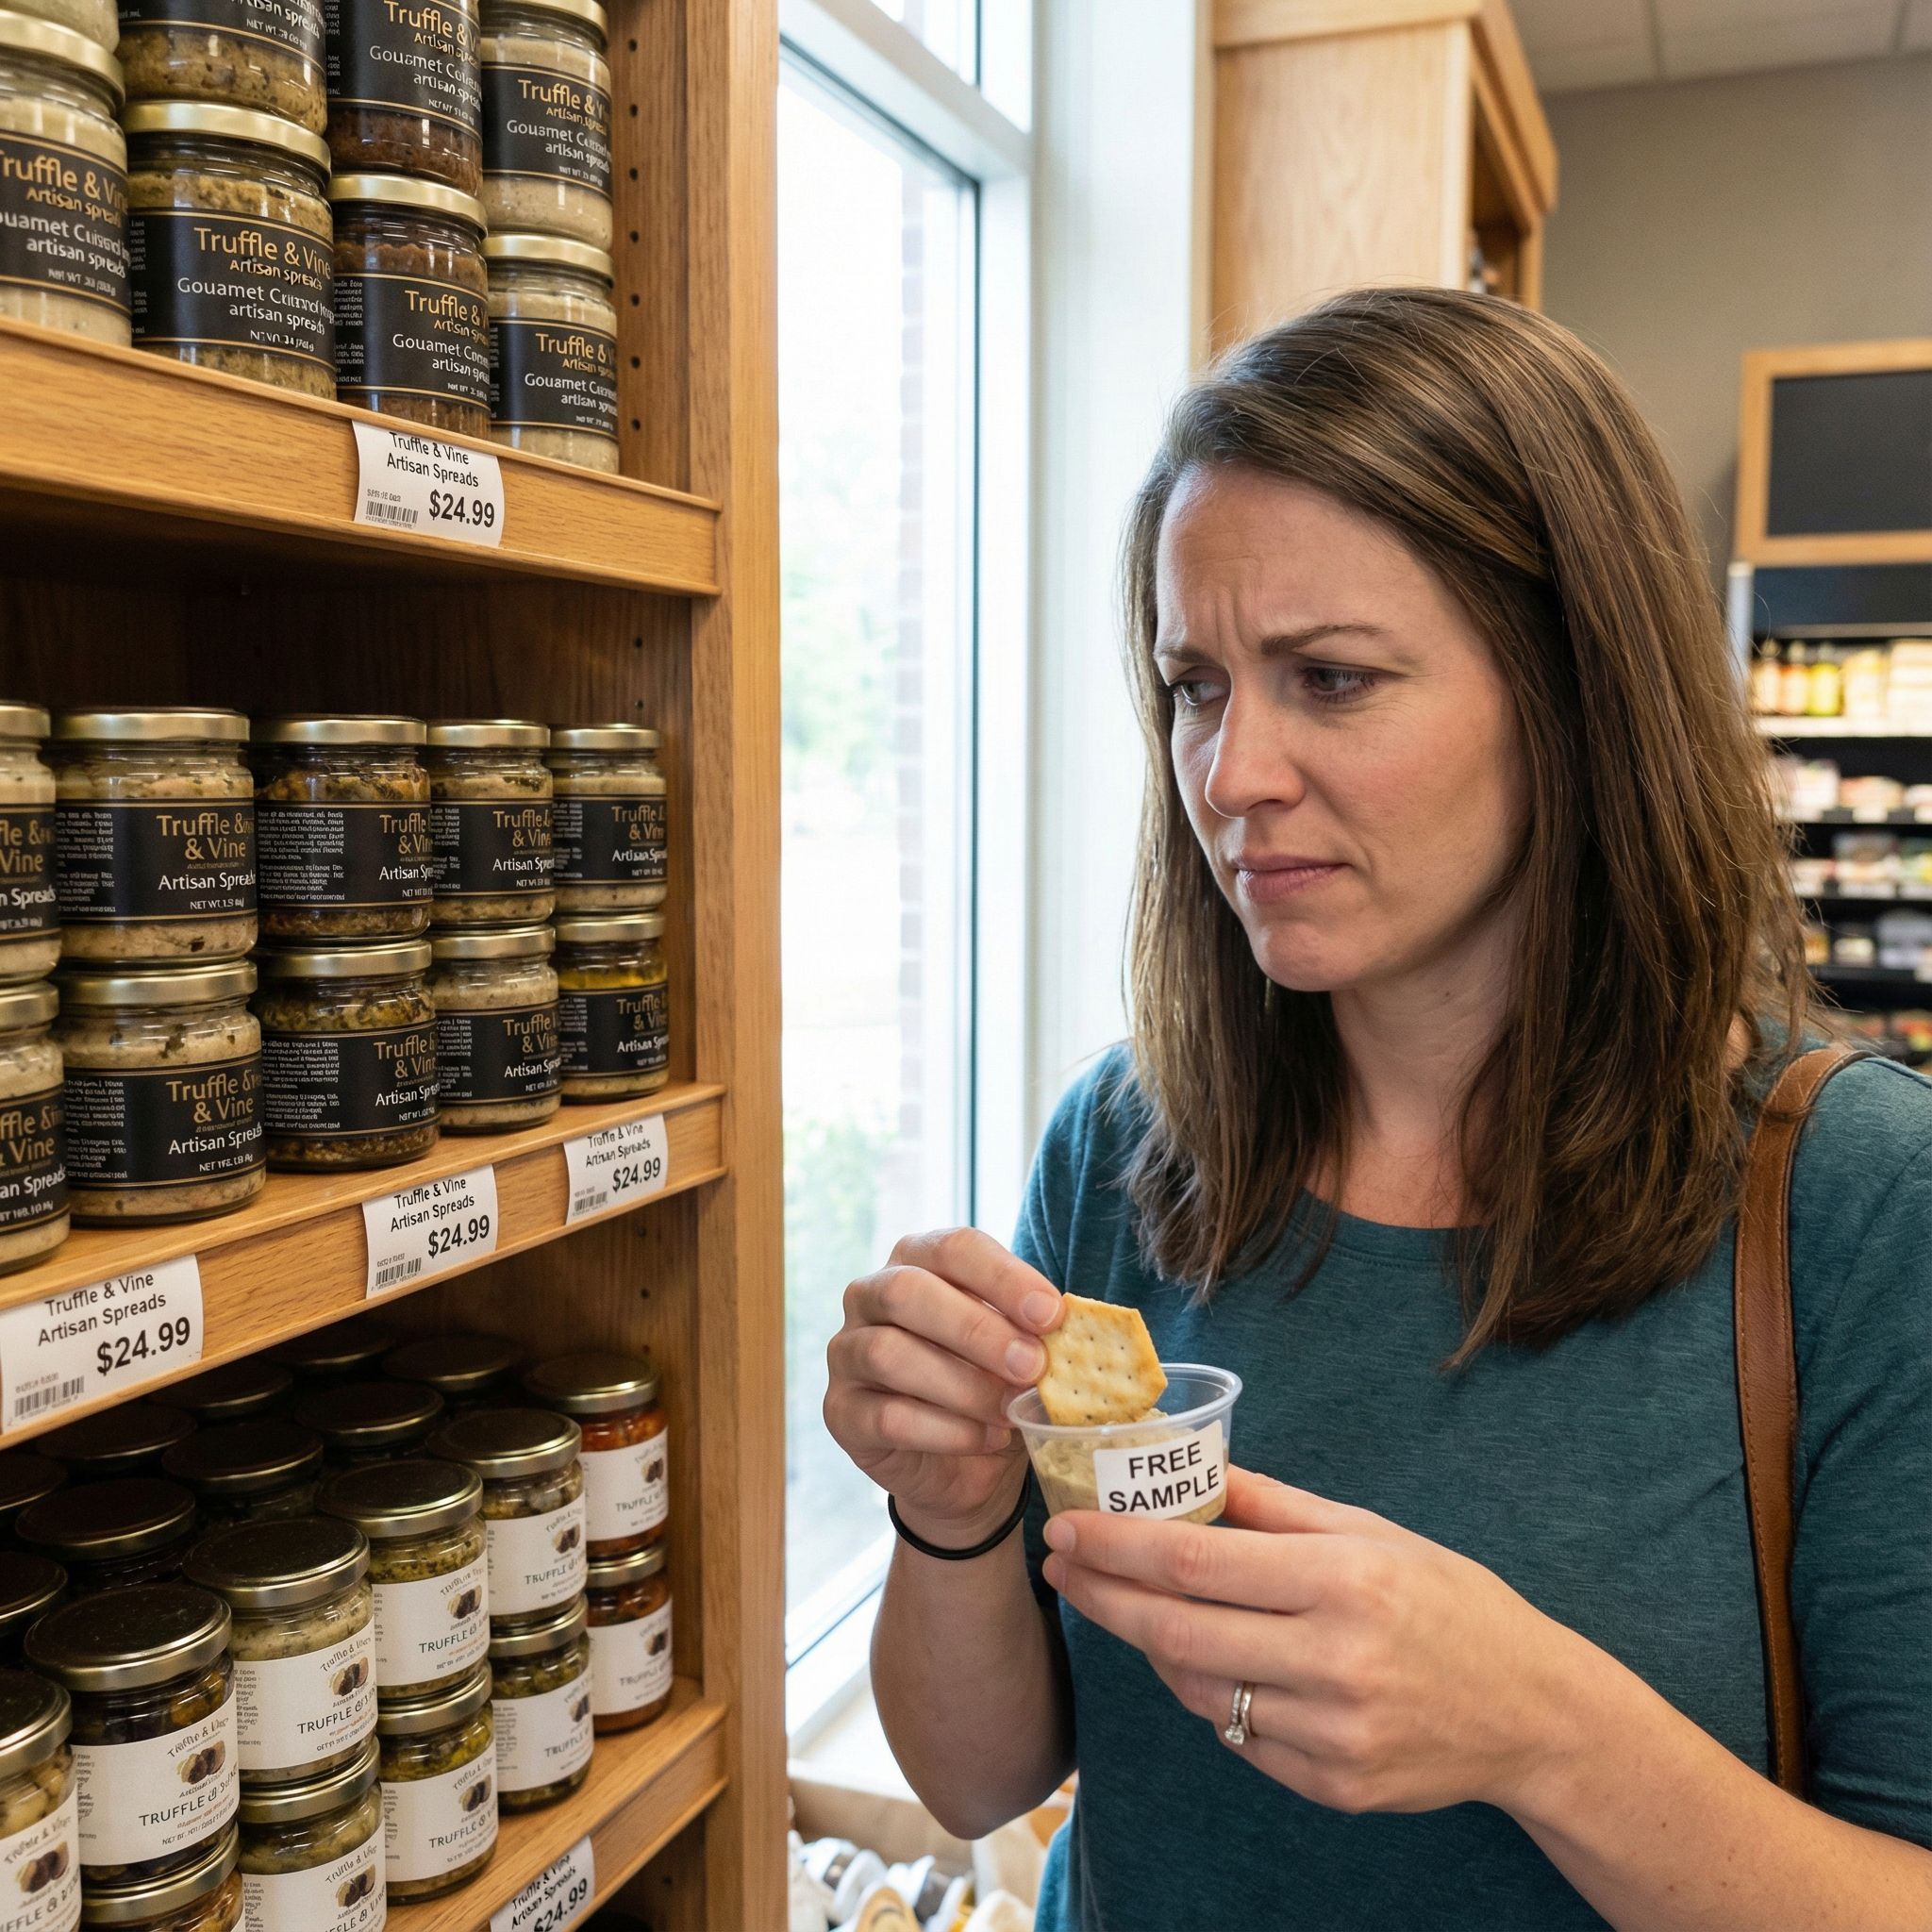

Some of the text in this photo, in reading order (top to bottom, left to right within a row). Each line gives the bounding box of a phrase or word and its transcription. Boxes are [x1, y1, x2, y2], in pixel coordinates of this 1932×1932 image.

[384, 0, 466, 45] Truffle &
[518, 79, 594, 115] Truffle &
[0, 151, 77, 192] ruffle
[85, 171, 101, 200] &
[26, 239, 85, 262] artisan
[193, 227, 330, 280] Truffle & Vine
[229, 303, 282, 323] artisan
[405, 290, 480, 326] Truffle &
[536, 333, 593, 358] Truffle
[432, 358, 471, 376] artisan
[390, 432, 469, 464] Truffle & Vine
[387, 453, 478, 488] Artisan Spreads
[429, 489, 494, 528] $24.99
[157, 812, 243, 836] Truffle &
[379, 813, 425, 833] Truffle
[492, 809, 542, 827] Truffle
[185, 837, 245, 859] & Vine
[398, 835, 411, 855] &
[512, 830, 525, 847] &
[0, 848, 43, 874] Vine
[379, 866, 419, 881] Artisan
[492, 858, 532, 871] Artisan
[158, 874, 215, 891] Artisan
[503, 1014, 551, 1036] Truffle
[374, 1035, 427, 1060] Truffle
[522, 1036, 533, 1053] &
[394, 1059, 408, 1078] &
[505, 1062, 541, 1077] Artisan
[166, 1073, 238, 1102] Truffle
[375, 1089, 417, 1107] Artisan
[193, 1102, 211, 1124] &
[216, 1096, 254, 1120] Vine
[8, 1137, 55, 1163] Vine
[169, 1137, 225, 1155] Artisan
[612, 1158, 660, 1192] $24.99
[394, 1179, 466, 1209] Truffle & Vine
[391, 1195, 475, 1233] Artisan Spreads
[428, 1214, 490, 1258] $24.99
[44, 1274, 154, 1316] Truffle & Vine
[38, 1294, 166, 1346] Artisan Spreads
[96, 1317, 191, 1376] $24.99
[1128, 1441, 1202, 1479] FREE
[1108, 1464, 1219, 1512] SAMPLE
[419, 1630, 468, 1654] TRUFFLE
[139, 1795, 206, 1826] TRUFFLE
